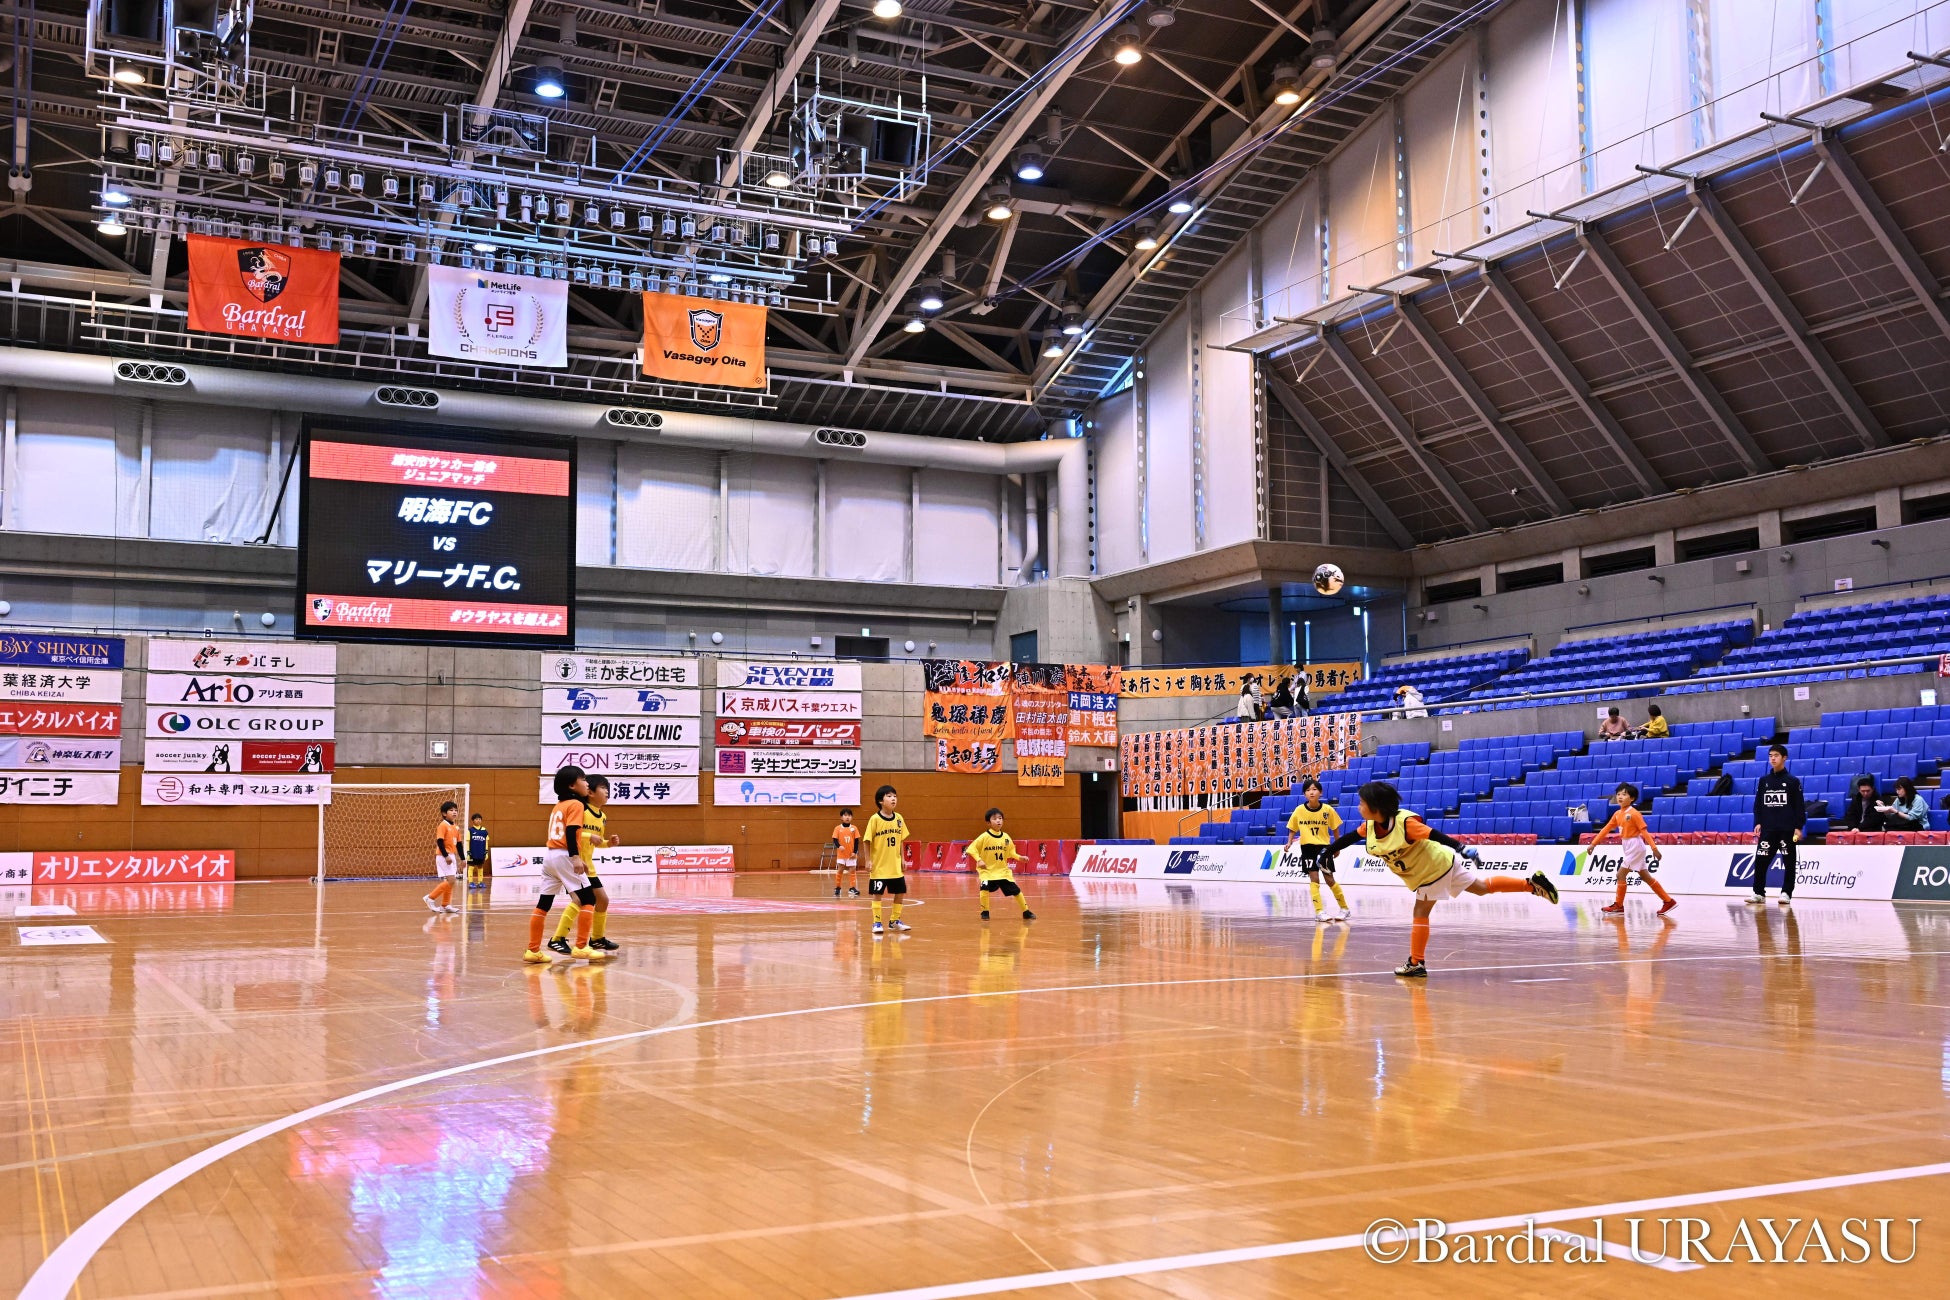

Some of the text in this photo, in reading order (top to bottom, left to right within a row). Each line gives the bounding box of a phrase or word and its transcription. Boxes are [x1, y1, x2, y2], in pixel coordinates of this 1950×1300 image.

[248, 280, 280, 291] Bardral
[490, 282, 522, 292] MetLife
[222, 302, 306, 330] Bardral
[226, 322, 302, 338] URAYASU
[460, 344, 537, 359] CHAMPIONS
[664, 350, 746, 367] Vasagey Oita
[404, 469, 485, 485] ジュニアマッチ
[398, 498, 492, 525] 明海FC
[366, 560, 521, 590] マリーナF.C.
[336, 602, 392, 618] Bardral
[38, 642, 110, 656] SHINKIN
[50, 655, 109, 664] 東京ベイ信用金庫
[748, 666, 834, 678] SEVENTH
[1012, 663, 1018, 672] 7
[600, 665, 686, 682] かまとり住宅
[3, 673, 90, 690] 葉経済大学
[746, 676, 808, 686] PLACE
[180, 678, 254, 702] Ario
[258, 690, 304, 698] アリオ葛西
[741, 698, 857, 712] 京成バス 千葉ウエスト
[1014, 696, 1020, 708] 4
[1070, 694, 1116, 710] 片岡浩太
[0, 710, 118, 730] エンタルバイオ
[1016, 712, 1068, 724] 田村龍太郎
[197, 718, 324, 730] OLC GROUP
[588, 722, 682, 740] HOUSE CLINIC
[748, 724, 854, 738] 車検のコバック
[1056, 726, 1064, 739] 9
[52, 750, 114, 760] 神楽坂スポーツ
[614, 753, 660, 761] イオン新浦安
[722, 754, 743, 764] 学生
[751, 758, 856, 774] 学生ナビステーション
[1021, 764, 1062, 778] 大橋広弥
[1154, 783, 1160, 793] 4
[1166, 783, 1172, 793] 5
[1189, 782, 1194, 792] 7
[1200, 780, 1206, 791] 8
[1212, 780, 1217, 790] 9
[1224, 779, 1232, 790] 10
[1236, 778, 1244, 789] 14
[1248, 778, 1257, 788] 15
[1276, 777, 1284, 788] 18
[188, 784, 314, 796] 和牛専門 マルヨシ商事
[607, 782, 670, 800] 海大学
[1134, 784, 1138, 794] 2
[1146, 784, 1150, 794] 3
[1766, 794, 1786, 803] DAL
[1311, 828, 1319, 836] 17
[887, 837, 896, 847] 19
[994, 852, 1004, 861] 14
[38, 854, 230, 880] オリエンタルバイオ
[1193, 862, 1224, 873] Consulting
[1304, 859, 1314, 868] 17
[1478, 862, 1528, 870] 2025-26
[1585, 876, 1642, 886] メットライ生命
[1913, 866, 1950, 886] RO
[874, 880, 883, 890] 19
